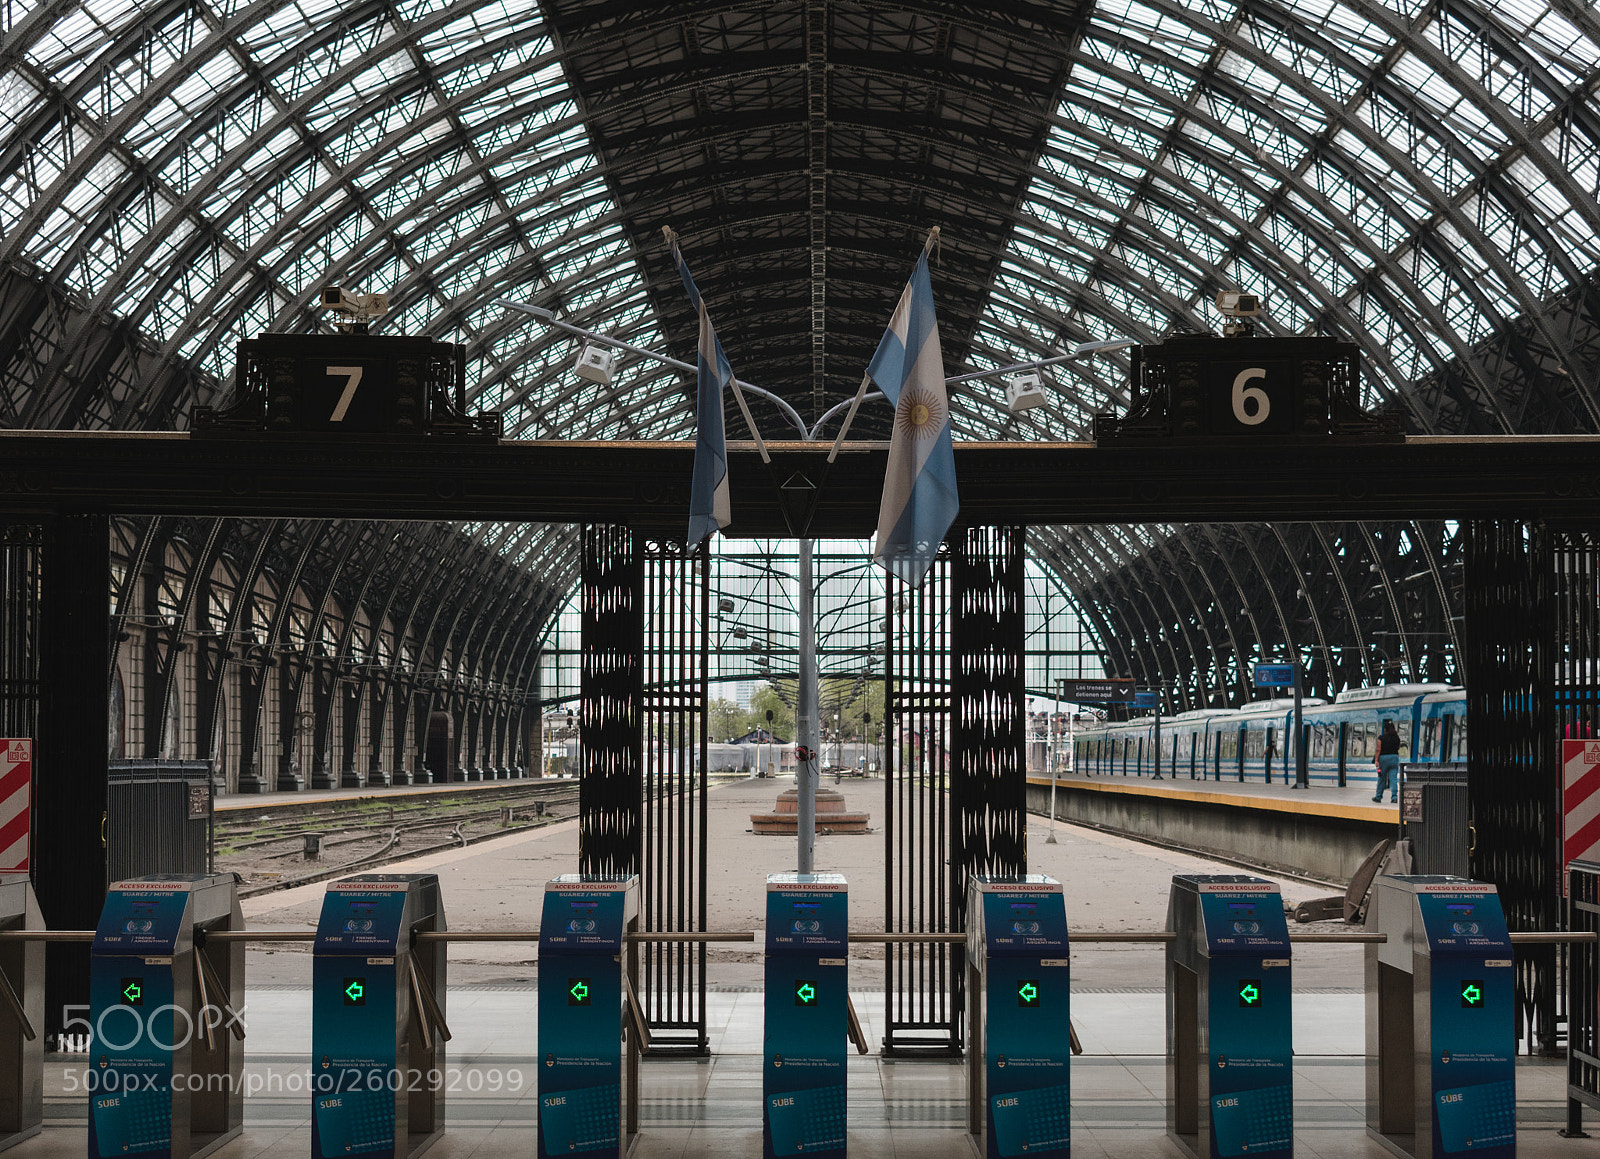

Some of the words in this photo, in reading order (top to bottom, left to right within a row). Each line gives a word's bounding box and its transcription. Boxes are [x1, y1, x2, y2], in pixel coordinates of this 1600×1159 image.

[326, 366, 363, 422] 7
[1232, 368, 1270, 425] 6
[1262, 674, 1267, 682] 6
[98, 1098, 120, 1108] SUBE
[320, 1099, 342, 1109] SUBE
[544, 1097, 566, 1107] SUBE
[772, 1097, 794, 1107] SUBE
[997, 1098, 1019, 1107] SUBE
[1217, 1098, 1239, 1108] SUBE
[1441, 1094, 1463, 1104] SUBE
